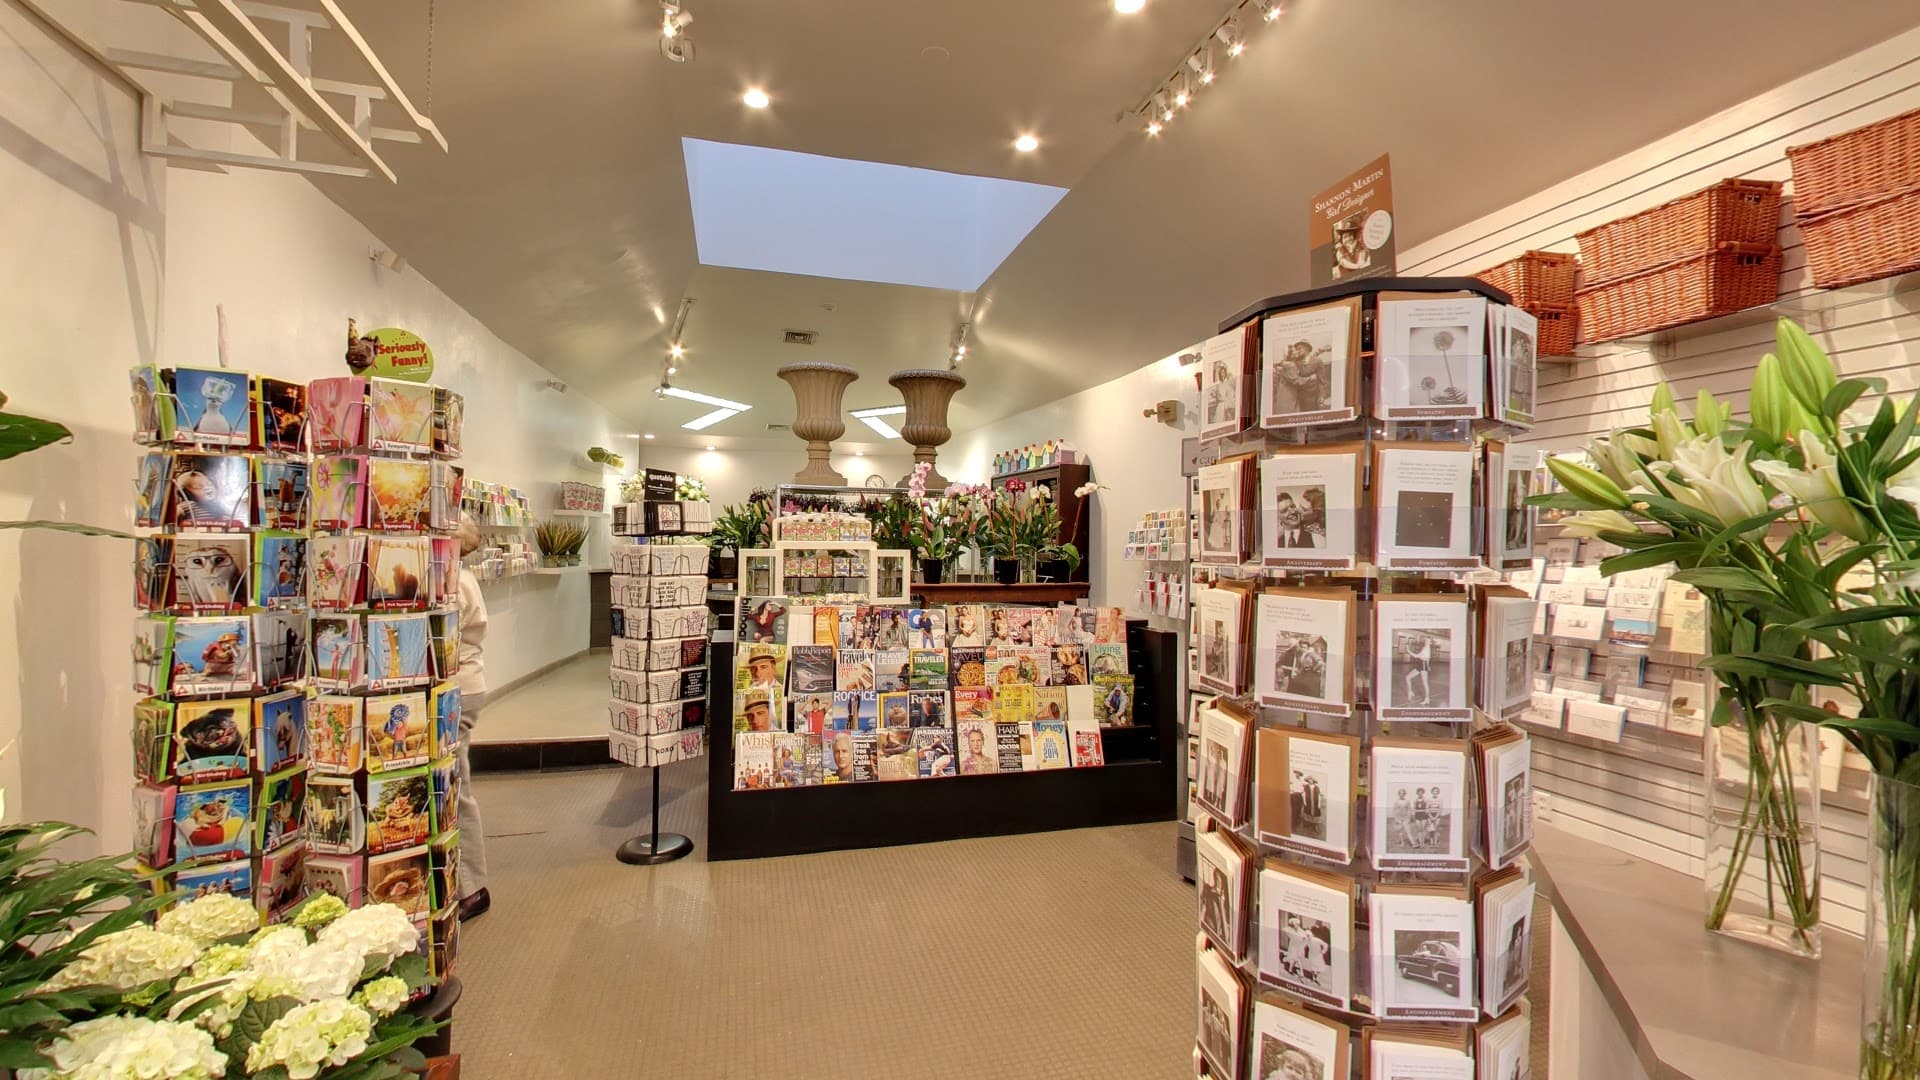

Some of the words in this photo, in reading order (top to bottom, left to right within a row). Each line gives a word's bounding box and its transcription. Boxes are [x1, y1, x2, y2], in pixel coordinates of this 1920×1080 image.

[378, 341, 426, 354] Seriously
[1094, 645, 1121, 655] Living
[955, 690, 978, 698] Every
